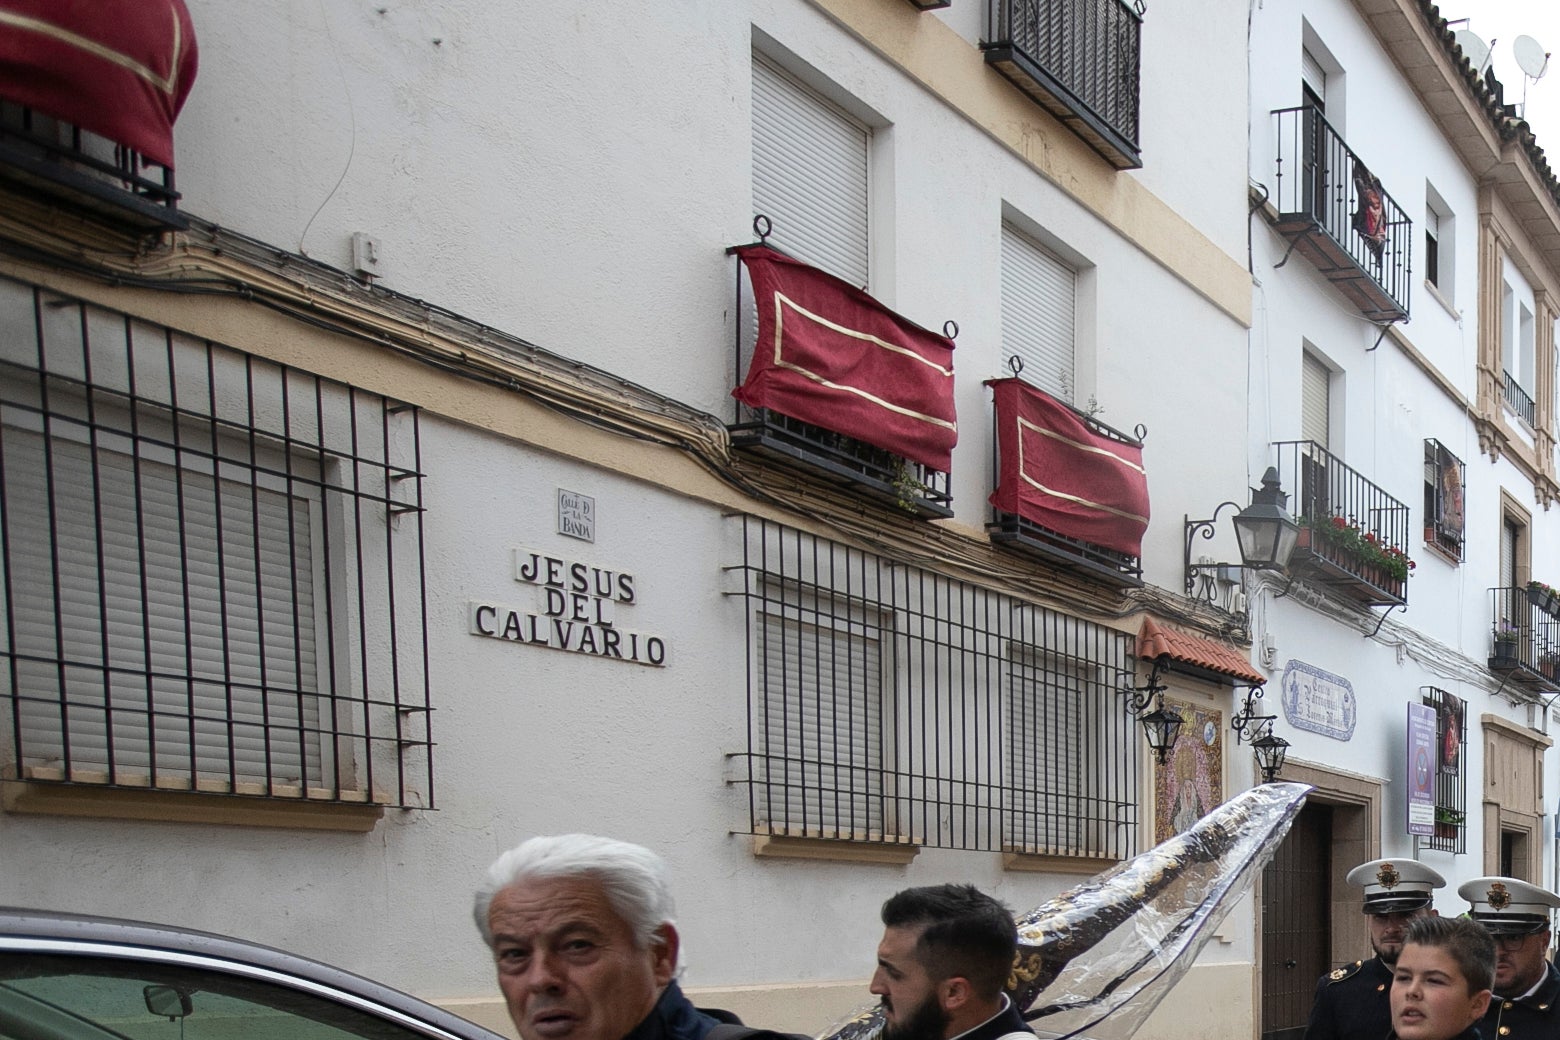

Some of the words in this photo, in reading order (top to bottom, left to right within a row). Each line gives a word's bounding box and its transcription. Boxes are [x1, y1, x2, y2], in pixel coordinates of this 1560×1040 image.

[563, 517, 591, 538] BANDA
[520, 553, 635, 603] JESUS
[544, 586, 613, 628] DEL
[476, 605, 666, 665] CALVARIO
